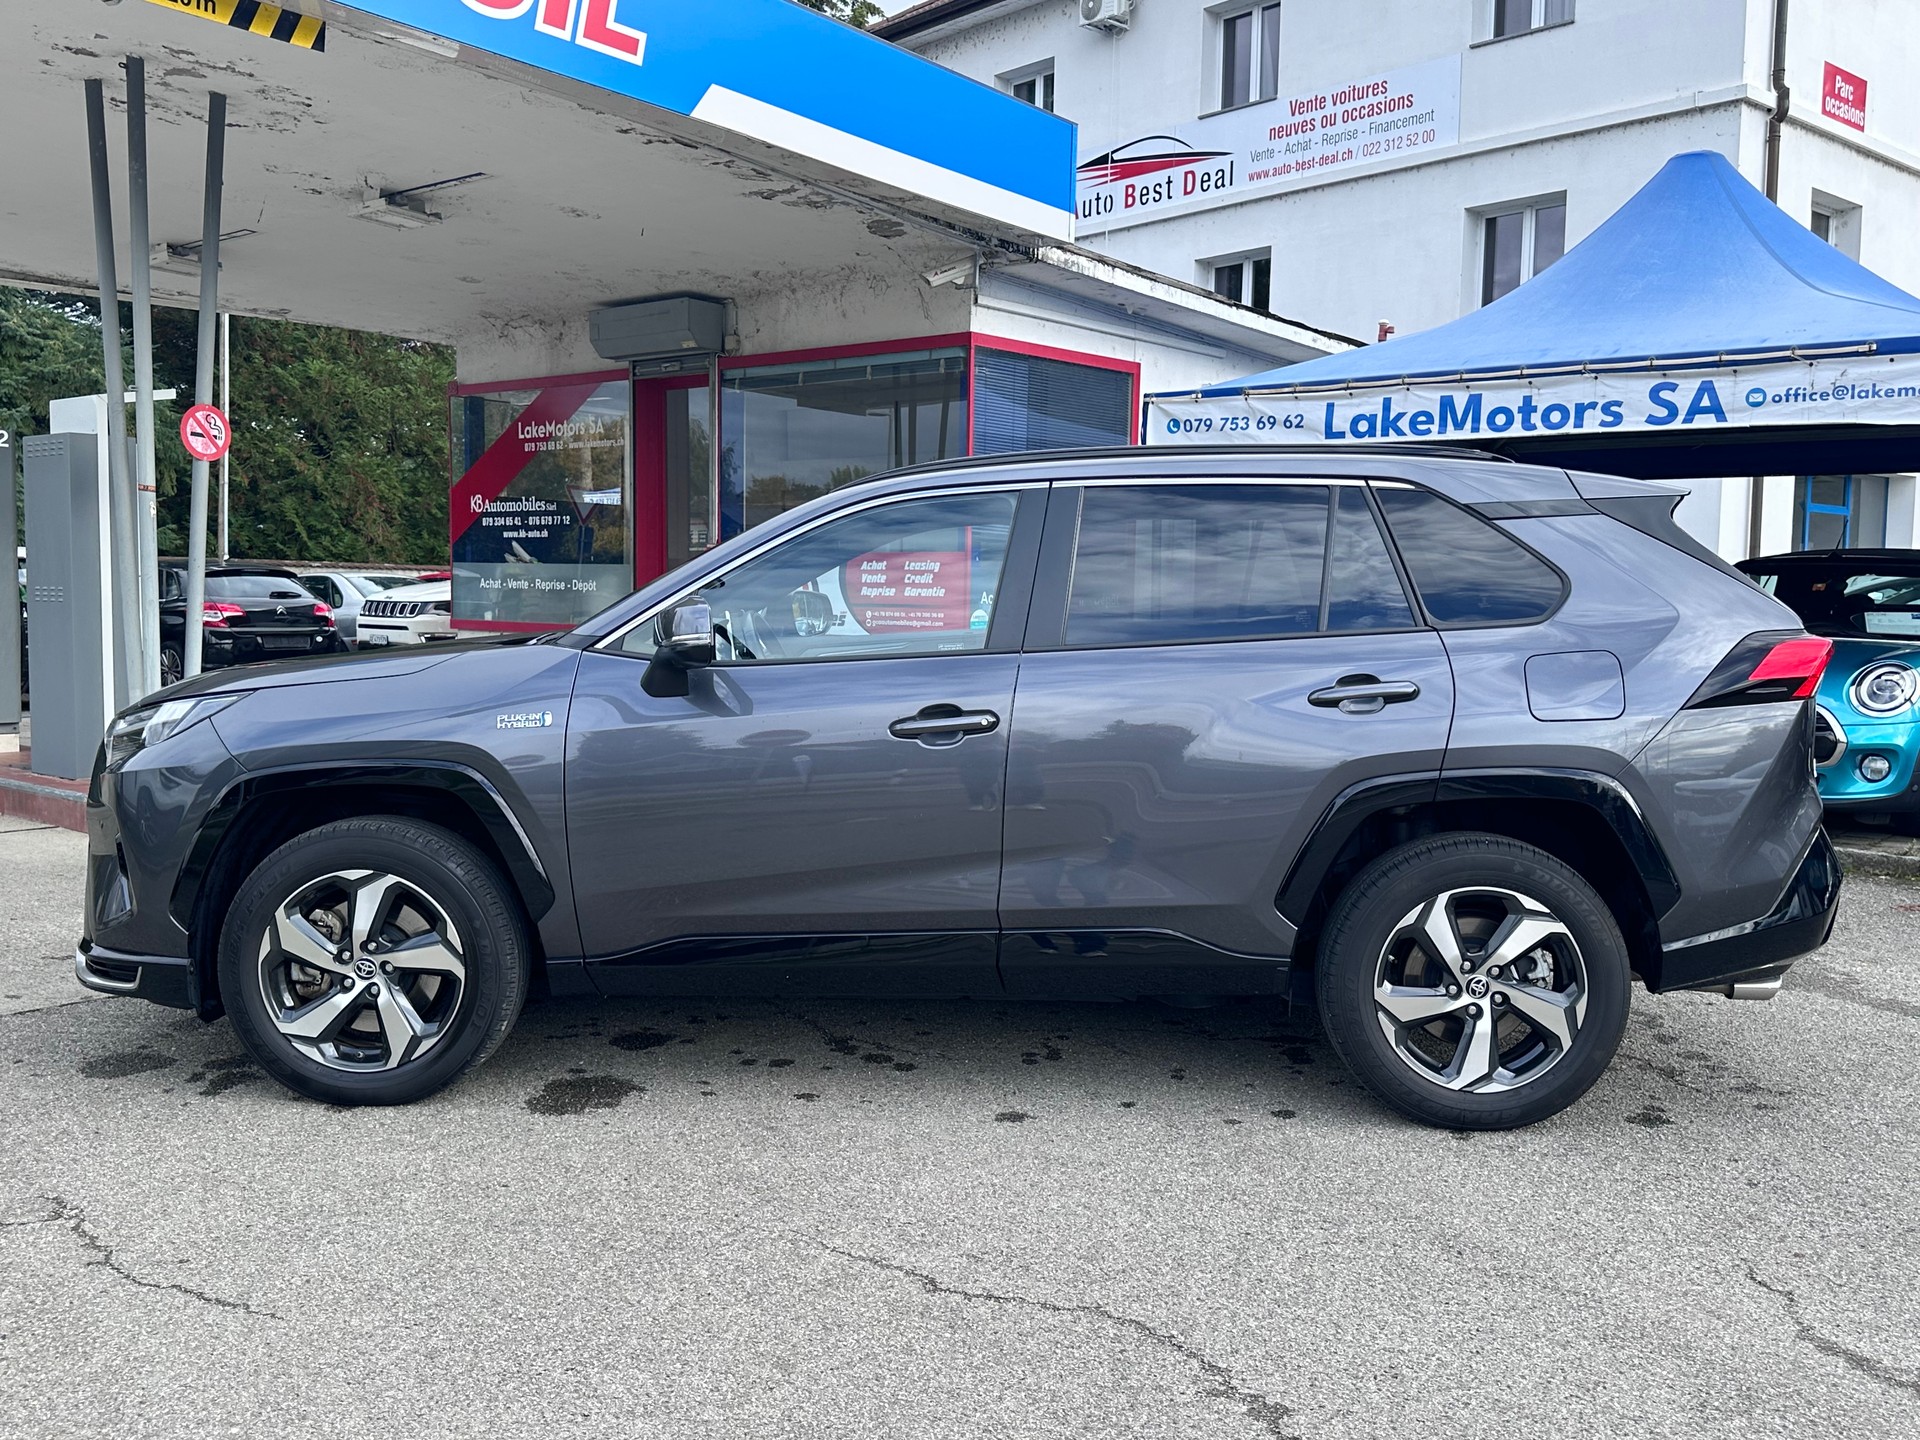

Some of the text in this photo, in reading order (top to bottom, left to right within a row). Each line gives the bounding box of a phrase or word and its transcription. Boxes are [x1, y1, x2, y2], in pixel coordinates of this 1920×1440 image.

[1834, 74, 1854, 101] Parc
[1289, 79, 1388, 117] Vente voitures
[1269, 93, 1414, 141] neuves ou occasions
[1825, 95, 1865, 127] occasions
[1250, 147, 1275, 163] Vente
[1284, 138, 1312, 155] Achat
[1321, 128, 1358, 147] Reprise
[1369, 108, 1435, 136] Financement
[1248, 147, 1353, 182] www.auto-best-deal.ch
[1362, 142, 1381, 157] 022
[1384, 137, 1403, 152] 312
[1405, 133, 1419, 148] 52
[1422, 128, 1436, 143] 00
[1075, 160, 1234, 220] uto Best Deal
[1183, 379, 1920, 440] 079 753 69 62 LakeMotors SA office@lakem
[518, 420, 585, 439] LakeMotors
[524, 442, 535, 452] 079
[536, 441, 547, 451] 753
[548, 441, 556, 450] 69
[556, 440, 564, 450] 62
[568, 436, 624, 449] www.lakemotors.ch
[482, 517, 493, 526] 079
[493, 517, 505, 526] 334
[514, 516, 522, 526] 41
[528, 516, 540, 526] 076
[541, 516, 553, 525] 679
[553, 515, 562, 525] 77
[562, 515, 571, 525] 12
[502, 529, 549, 538] www.kb-auto.ch
[860, 560, 941, 573] Achat Leasing
[479, 578, 502, 589] Achat
[507, 578, 529, 590] Vente
[535, 579, 565, 593] Reprise
[572, 579, 597, 593] Dépôt
[860, 573, 887, 583] Vente
[860, 586, 946, 598] Reprise Garantie
[496, 712, 542, 721] PLUG-IN
[496, 720, 542, 730] HYBRID
